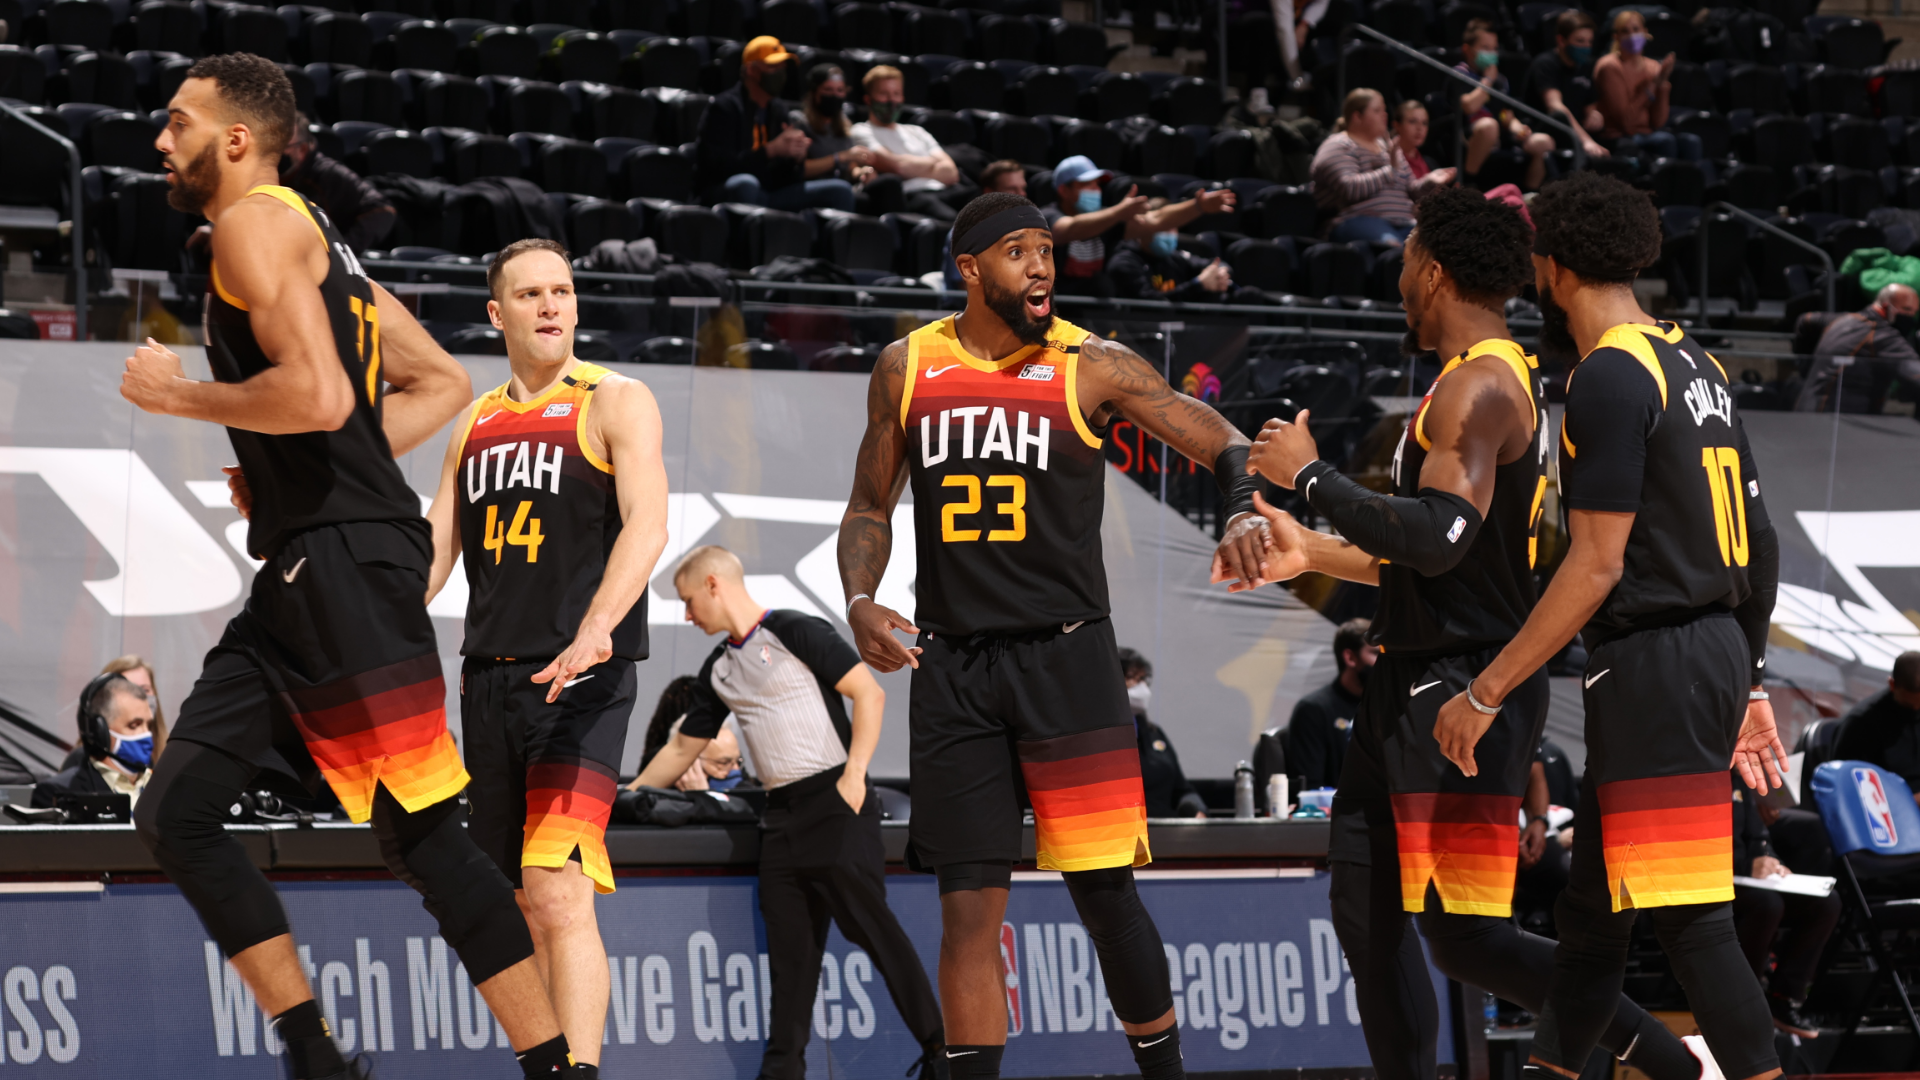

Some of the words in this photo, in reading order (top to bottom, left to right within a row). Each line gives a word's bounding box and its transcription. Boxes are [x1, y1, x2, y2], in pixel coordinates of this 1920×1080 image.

[1021, 365, 1033, 377] 5
[1684, 377, 1732, 427] CONLEY
[466, 440, 564, 504] UTAH
[920, 405, 1051, 472] UTAH
[483, 500, 546, 565] 44
[940, 474, 1027, 543] 23
[1702, 446, 1750, 568] 10
[0, 965, 81, 1065] ss
[1163, 940, 1306, 1051] eague
